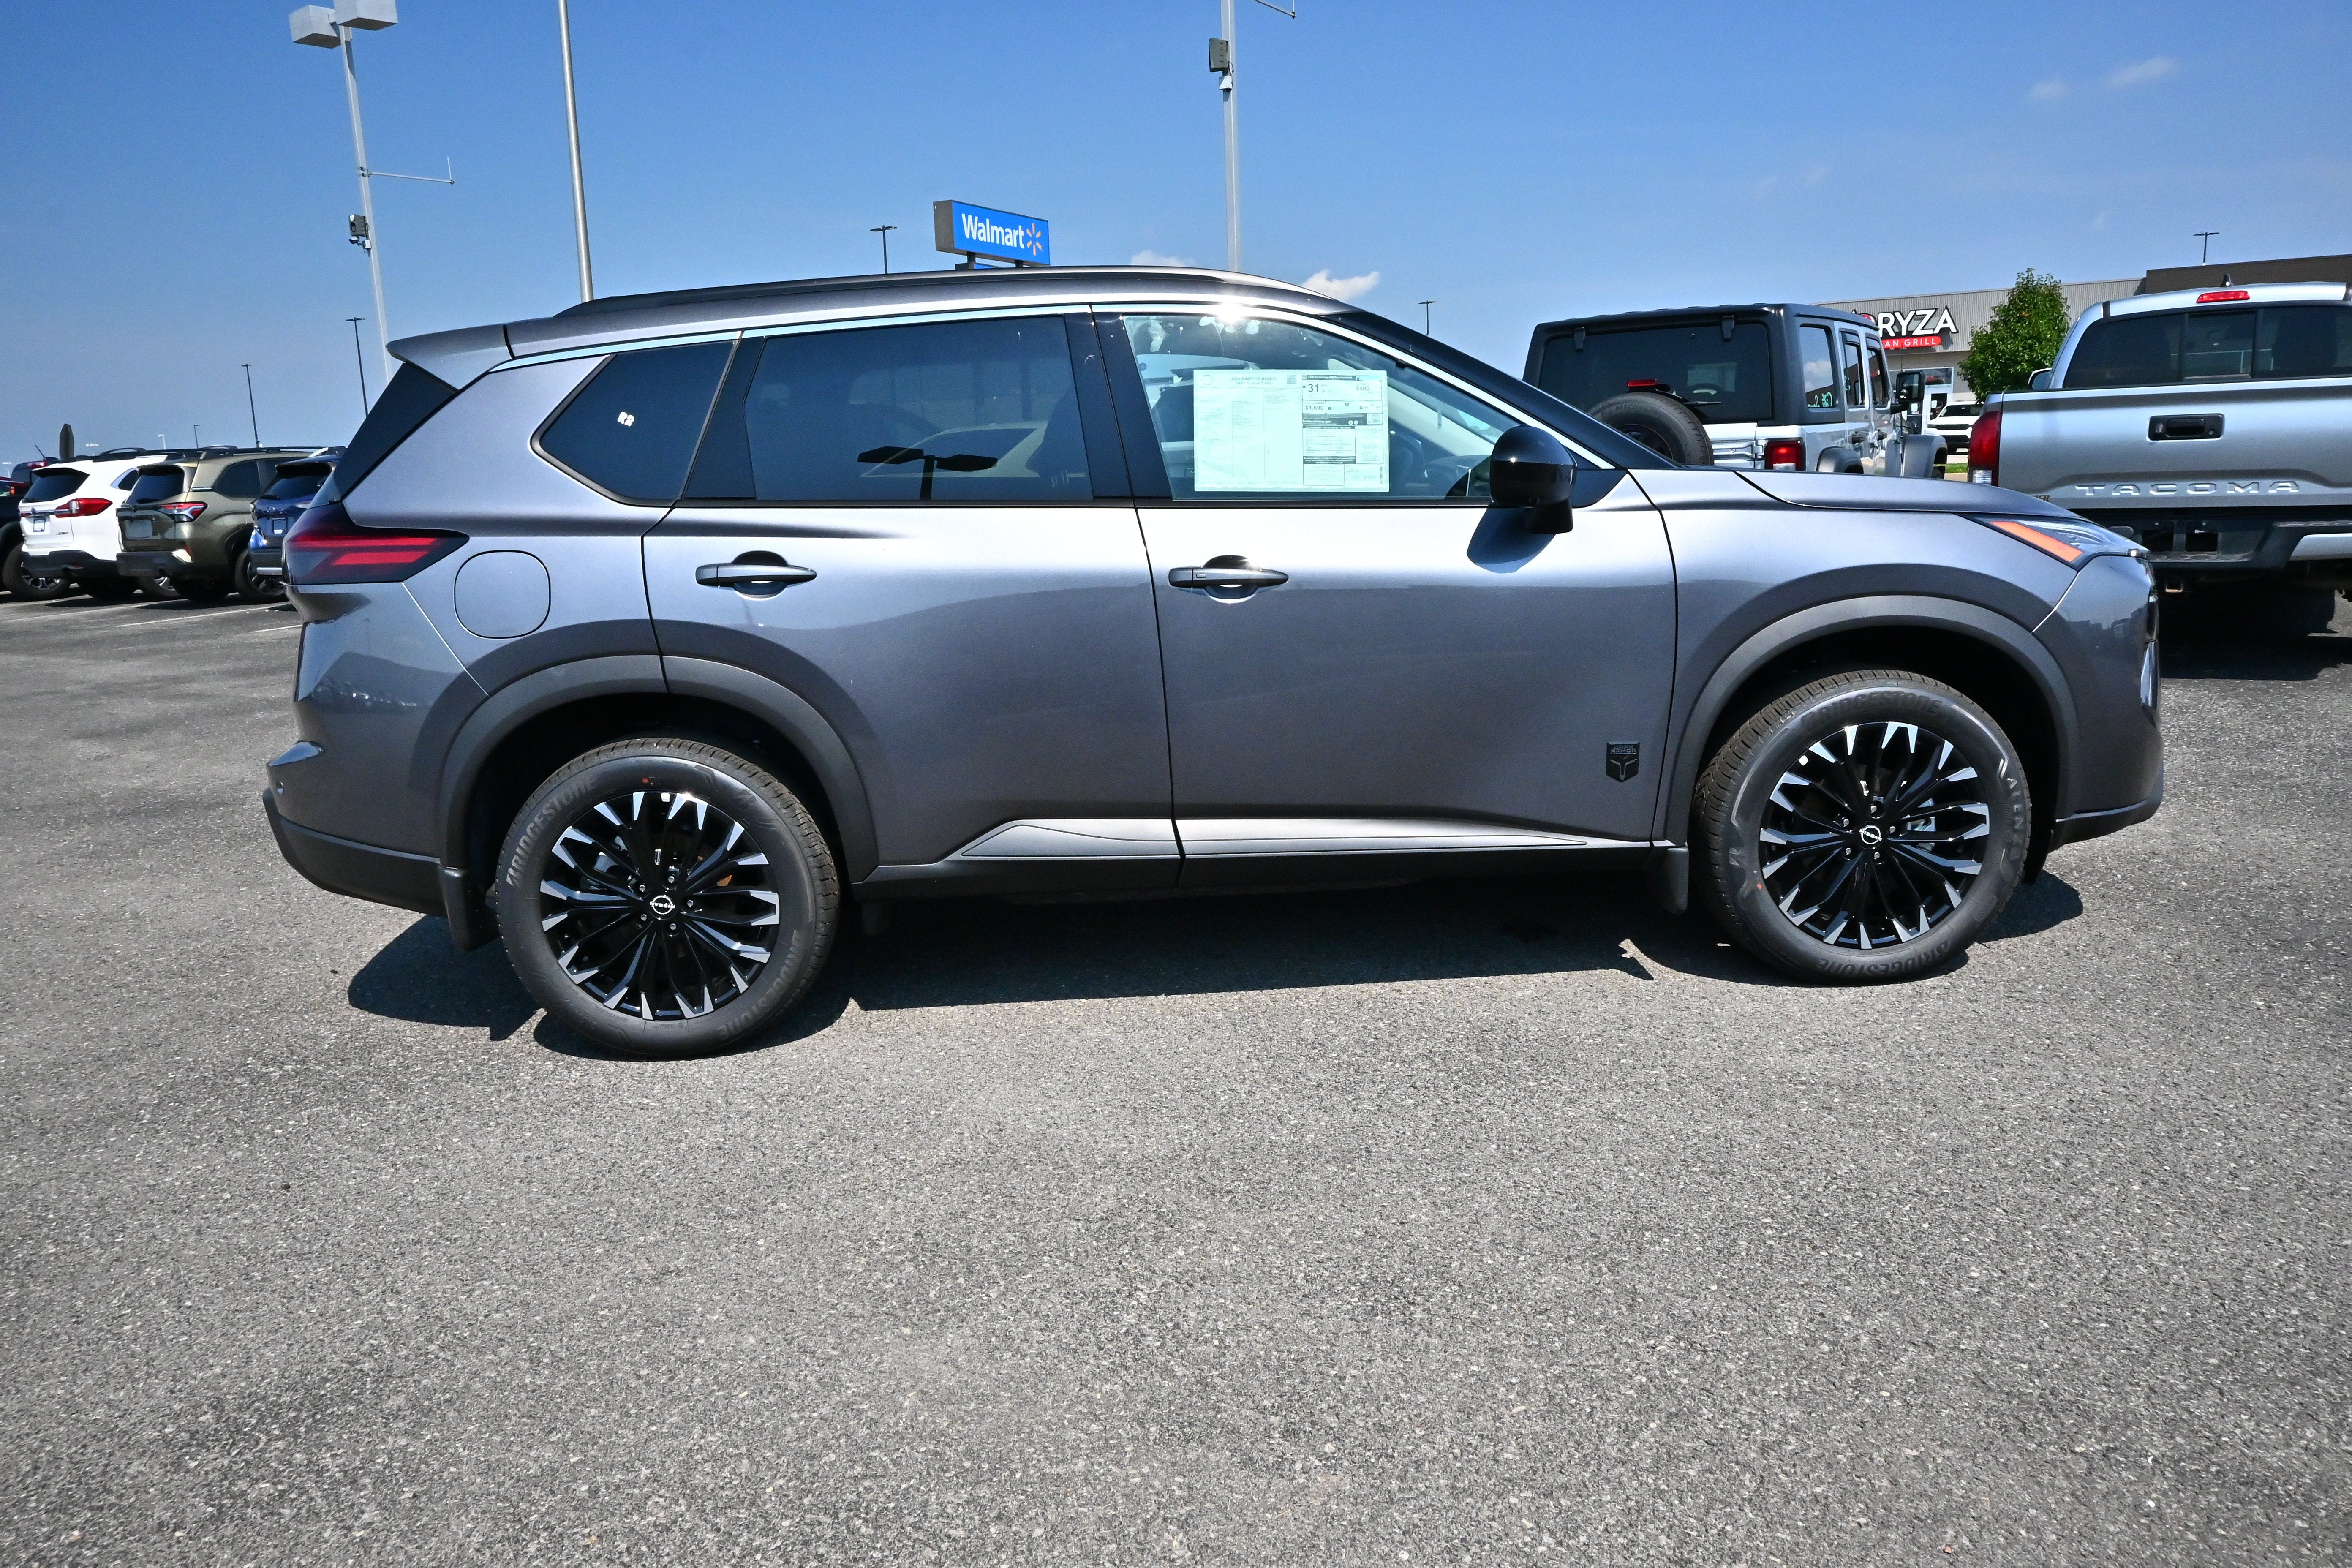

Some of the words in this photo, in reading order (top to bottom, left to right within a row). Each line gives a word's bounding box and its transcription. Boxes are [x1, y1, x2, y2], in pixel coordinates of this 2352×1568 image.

[961, 213, 1025, 249] Walmart
[1859, 308, 1957, 337] RYZA
[1904, 338, 1936, 346] GRILL
[1308, 384, 1319, 392] 31
[2076, 481, 2300, 496] TACOMA
[1800, 691, 1943, 724] BRIDGESTONE
[506, 776, 598, 889] BRIDGESTONE
[1859, 829, 1883, 841] NISSAN
[1817, 939, 1953, 976] BRIDGESTONE
[716, 928, 808, 1039] BRIDGESTONE
